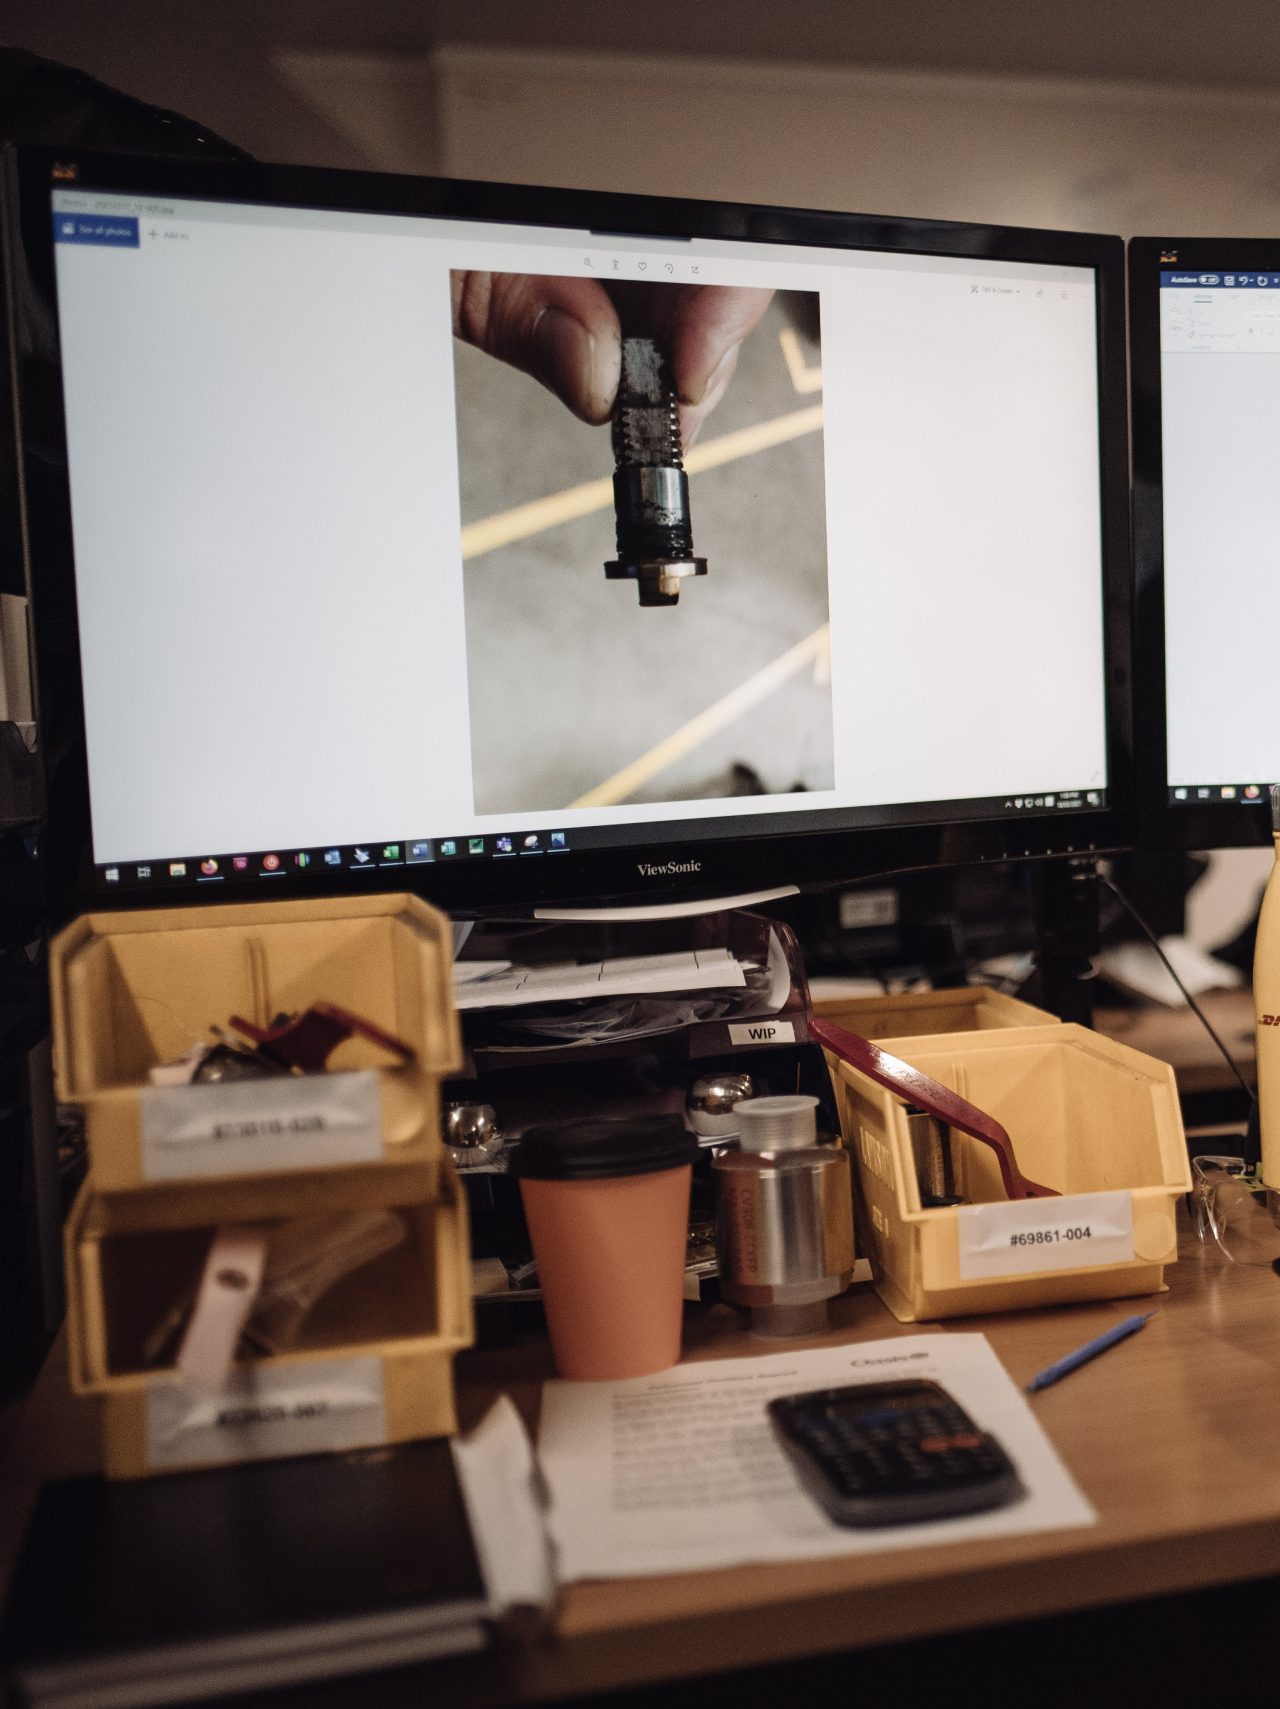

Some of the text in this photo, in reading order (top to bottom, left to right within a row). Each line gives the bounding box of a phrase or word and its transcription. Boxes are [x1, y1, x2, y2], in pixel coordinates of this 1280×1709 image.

[637, 860, 702, 877] ViewSonic
[748, 1027, 777, 1040] WIP
[1010, 1226, 1092, 1247] #69861-004
